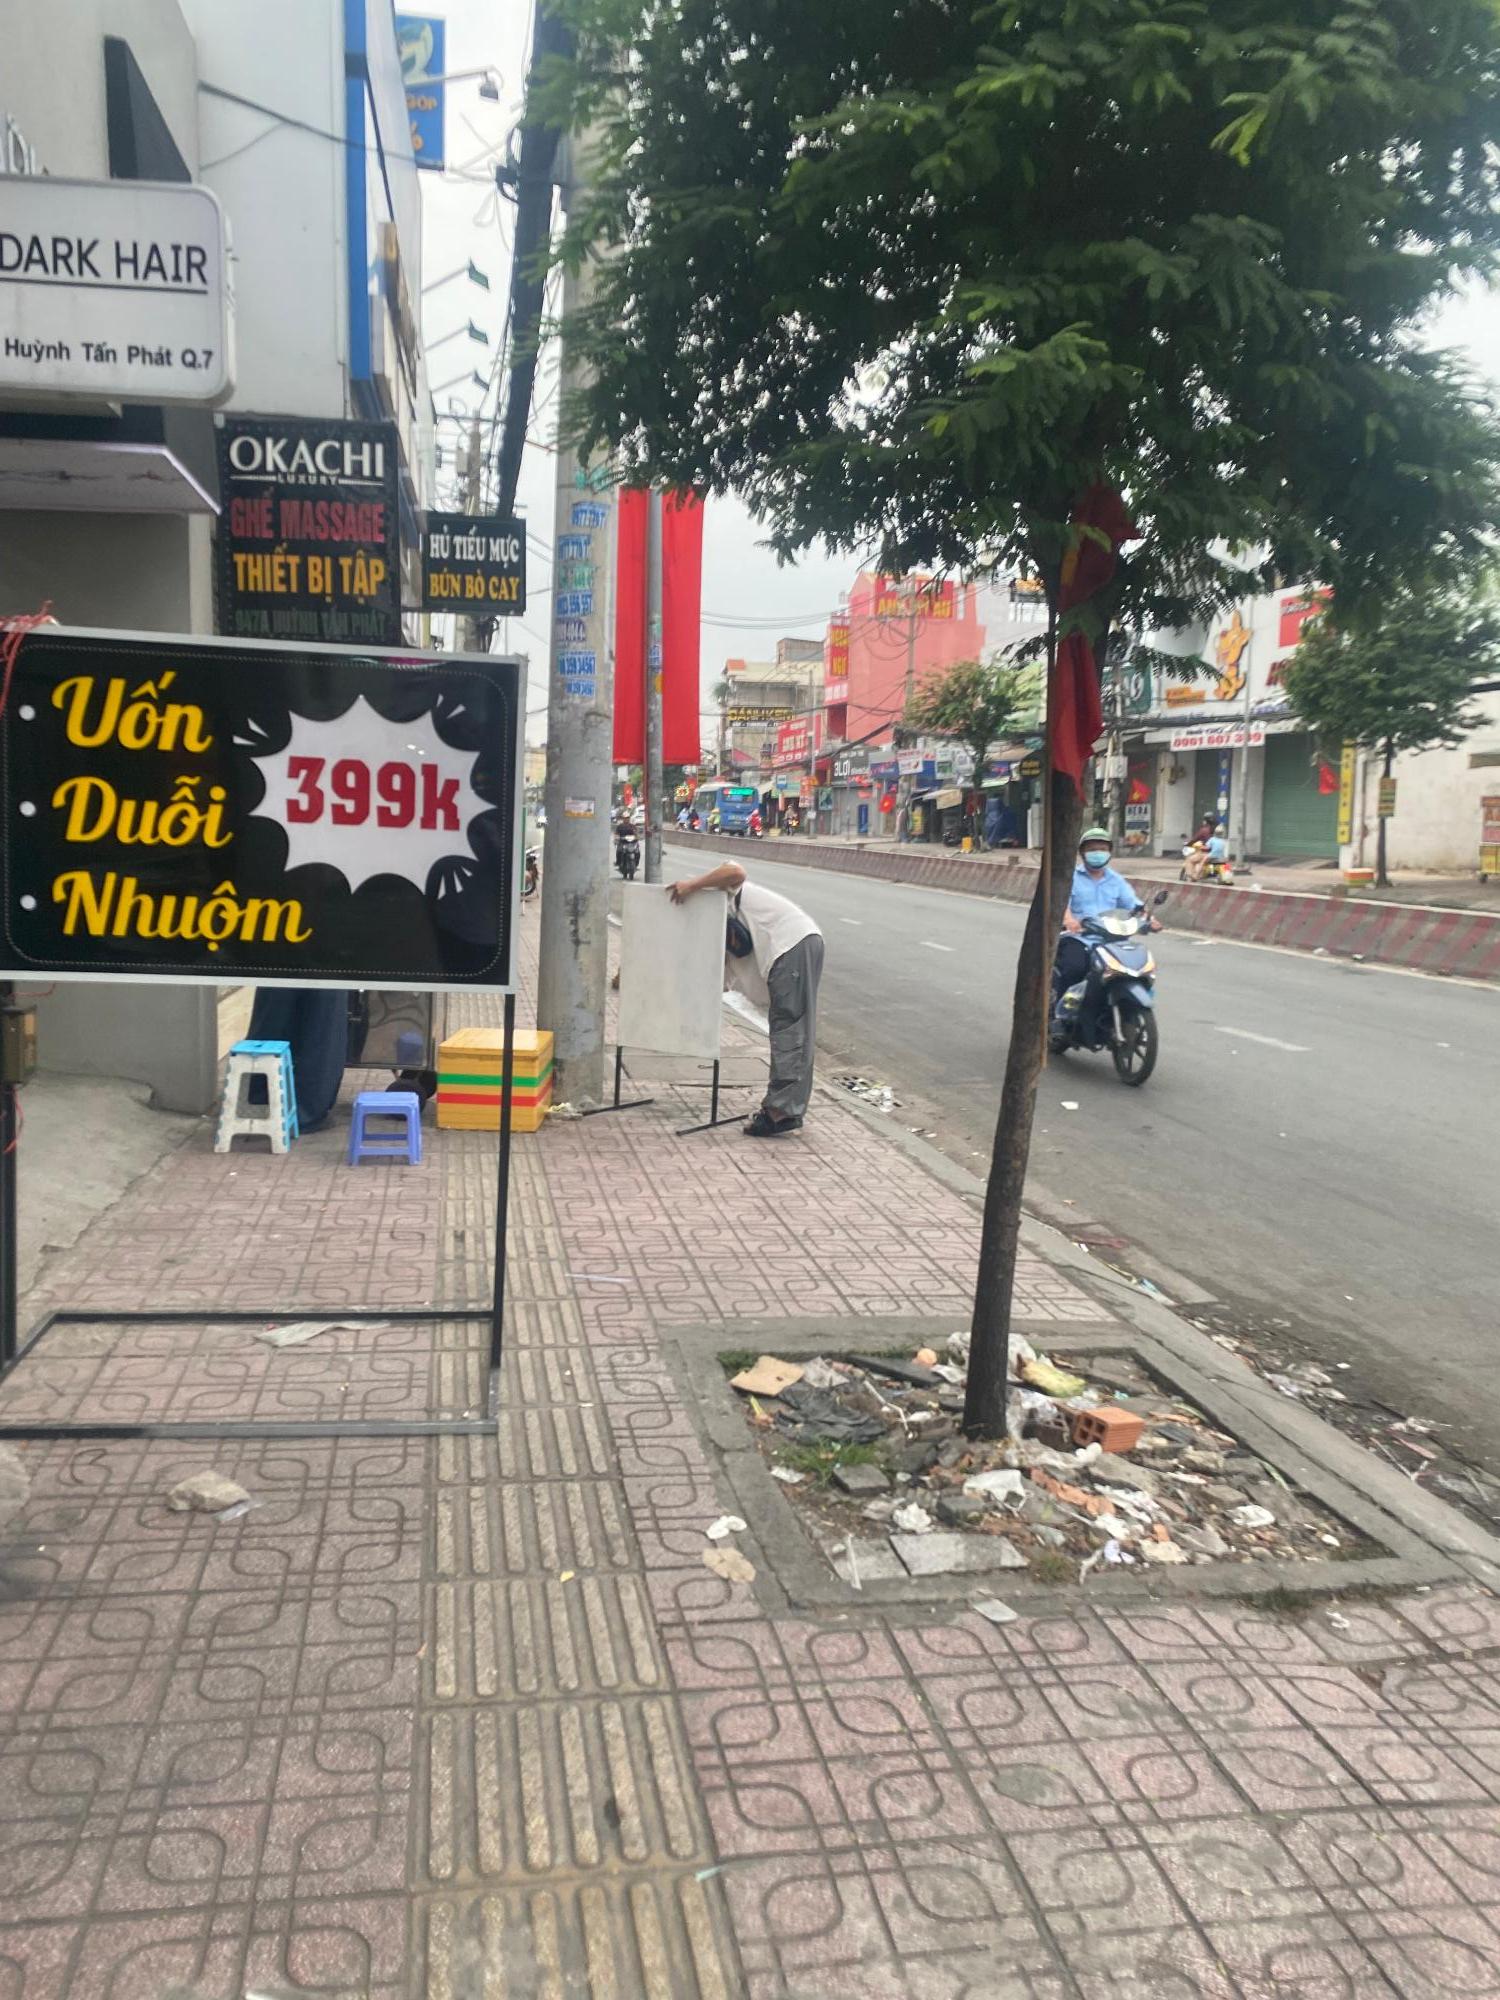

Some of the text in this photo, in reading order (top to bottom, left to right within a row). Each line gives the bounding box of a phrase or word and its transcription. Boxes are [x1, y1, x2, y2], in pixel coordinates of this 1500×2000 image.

[0, 233, 207, 285] DARK HAIR
[5, 338, 213, 370] Huỳnh Tấn Phát Q.7
[229, 436, 384, 478] OKACHI
[278, 473, 338, 485] LUXURY
[231, 486, 385, 543] GHẾ MASSAGE
[233, 541, 385, 605] THIẾT BỊ TẬP
[429, 524, 450, 559] HỦ
[489, 533, 520, 569] MỰC
[429, 567, 520, 601] BÚN BÒ CAY
[51, 671, 213, 753] Uốn
[52, 775, 233, 848] Duỗi
[286, 755, 460, 831] 399k
[52, 871, 313, 951] Nhuộm
